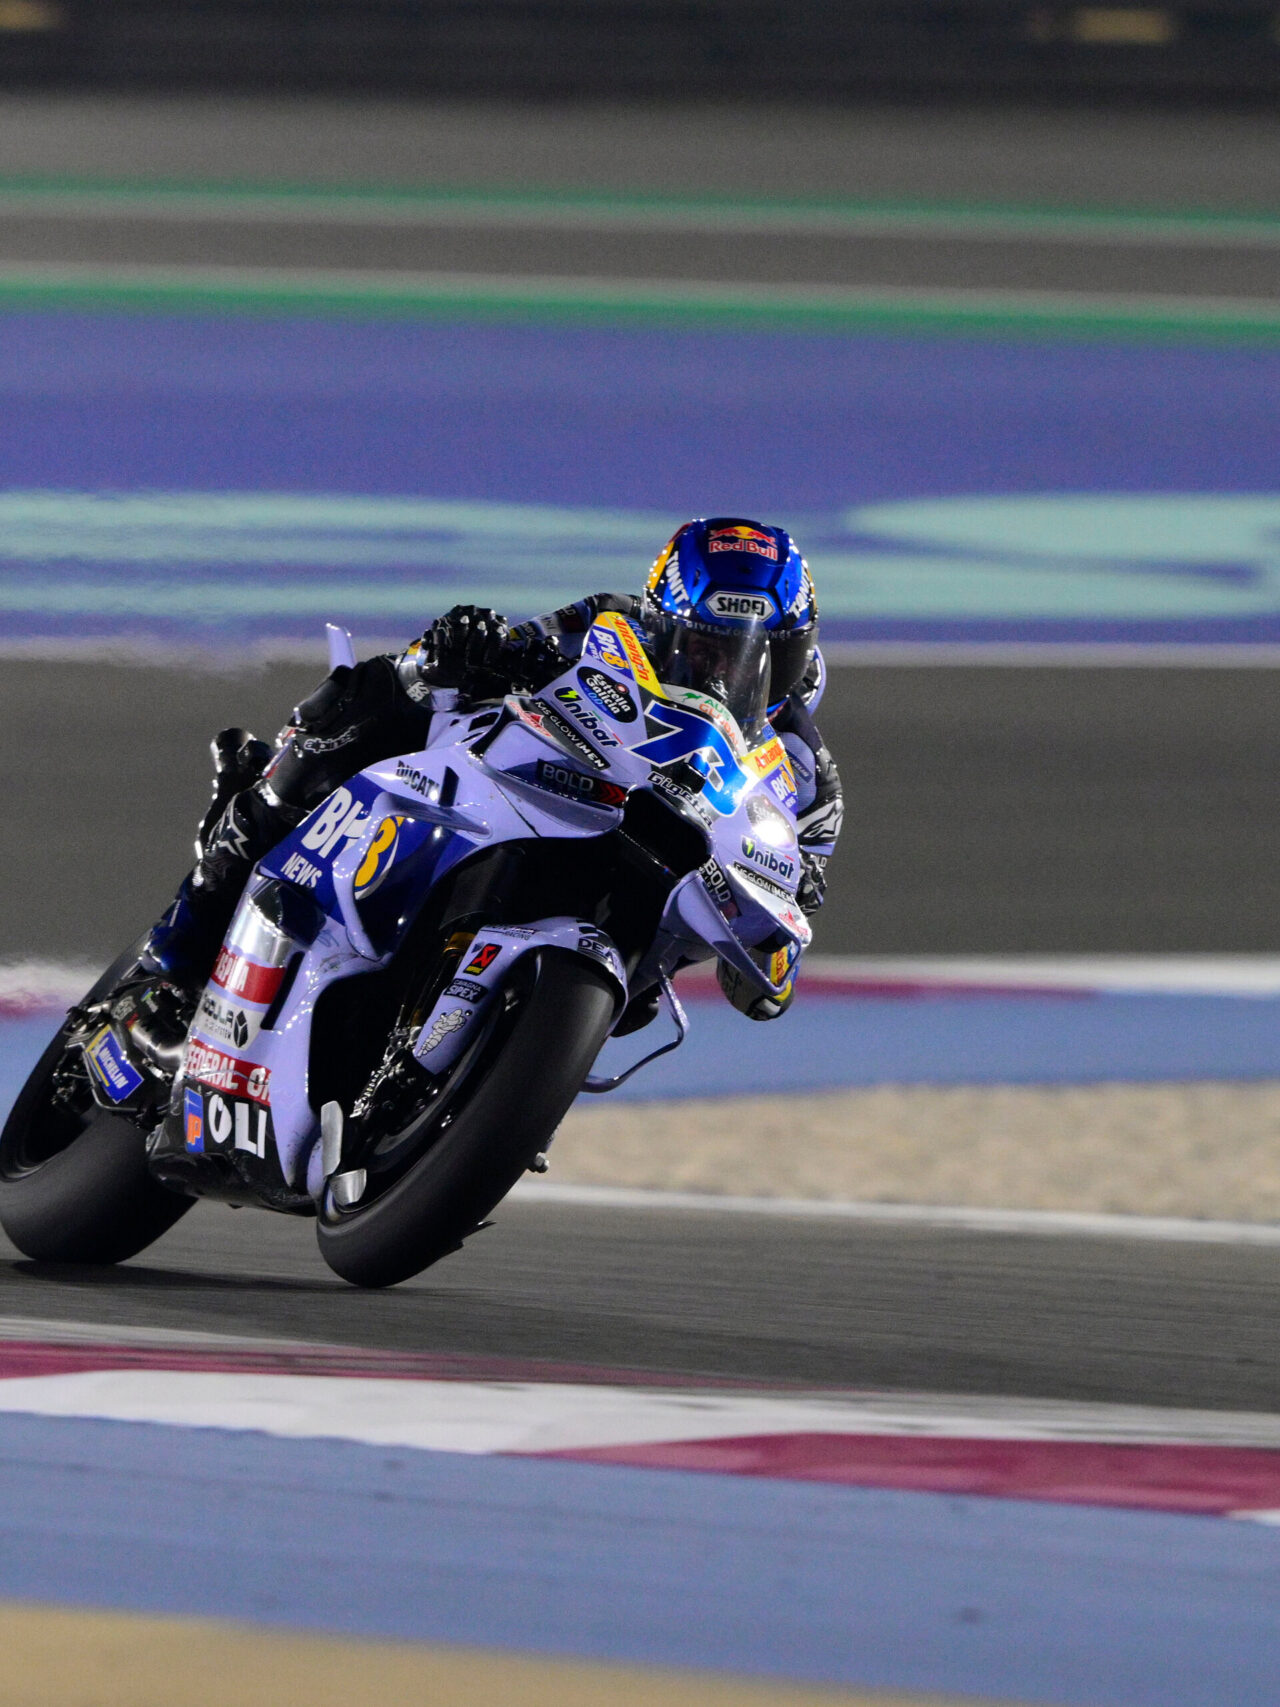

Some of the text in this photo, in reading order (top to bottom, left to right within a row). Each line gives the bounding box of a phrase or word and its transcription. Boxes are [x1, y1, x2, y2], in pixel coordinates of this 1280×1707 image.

[709, 539, 779, 561] Red Bull
[716, 596, 766, 617] SHOEI
[592, 628, 630, 670] BK8
[585, 677, 621, 715] Galicia
[591, 673, 631, 713] Estrella
[550, 714, 581, 745] GLOW
[553, 686, 622, 748] Unibat
[542, 763, 595, 792] BOLD
[624, 699, 749, 818] 73
[280, 852, 323, 889] NEWS
[741, 836, 795, 880] Unibat
[703, 858, 732, 903] BOLD
[445, 985, 479, 1001] SIPEX
[98, 1046, 130, 1090] MICHELIN
[186, 1045, 239, 1090] FEDERAL
[208, 1093, 268, 1160] OLI
